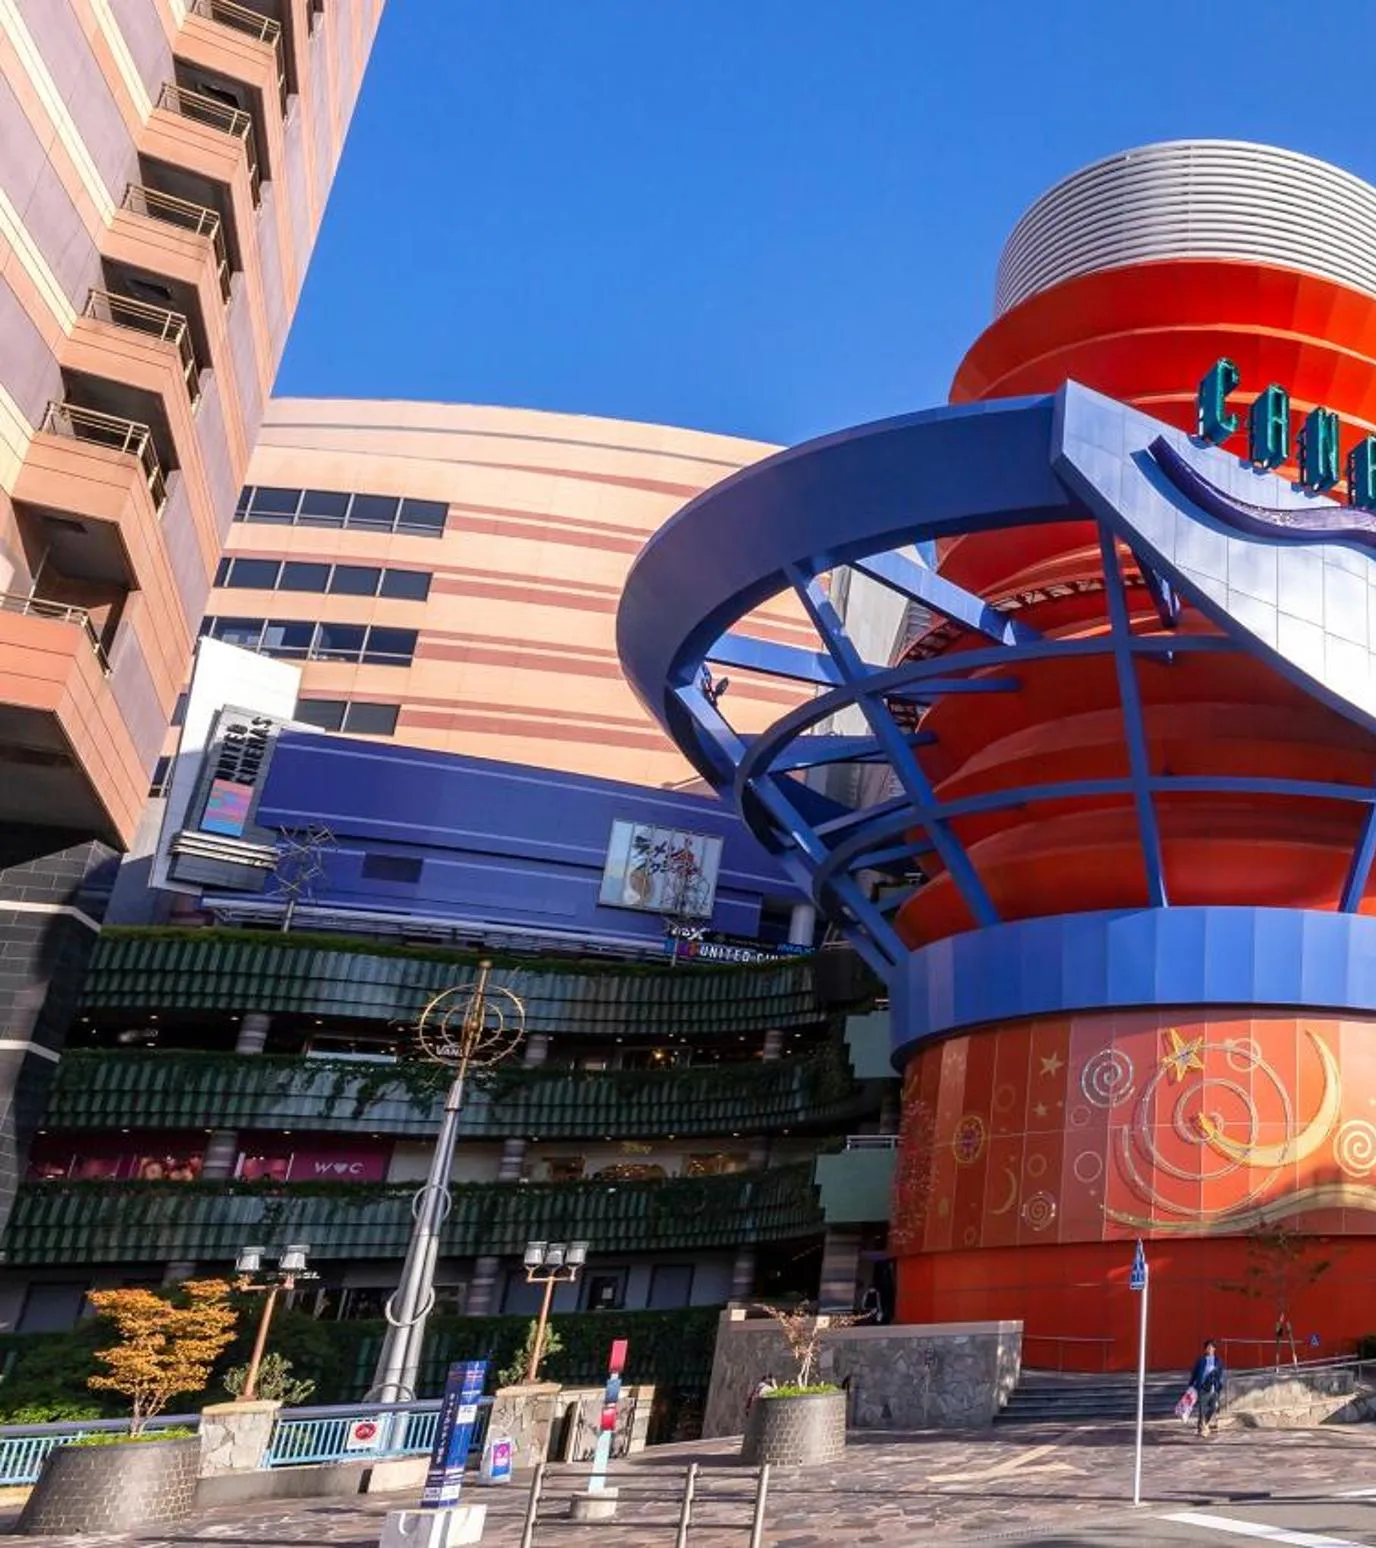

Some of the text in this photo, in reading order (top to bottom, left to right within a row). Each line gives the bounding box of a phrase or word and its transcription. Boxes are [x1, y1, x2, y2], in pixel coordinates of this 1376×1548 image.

[214, 723, 249, 780] UNITED
[236, 716, 273, 786] CINEMAS
[700, 944, 751, 963] UNITED
